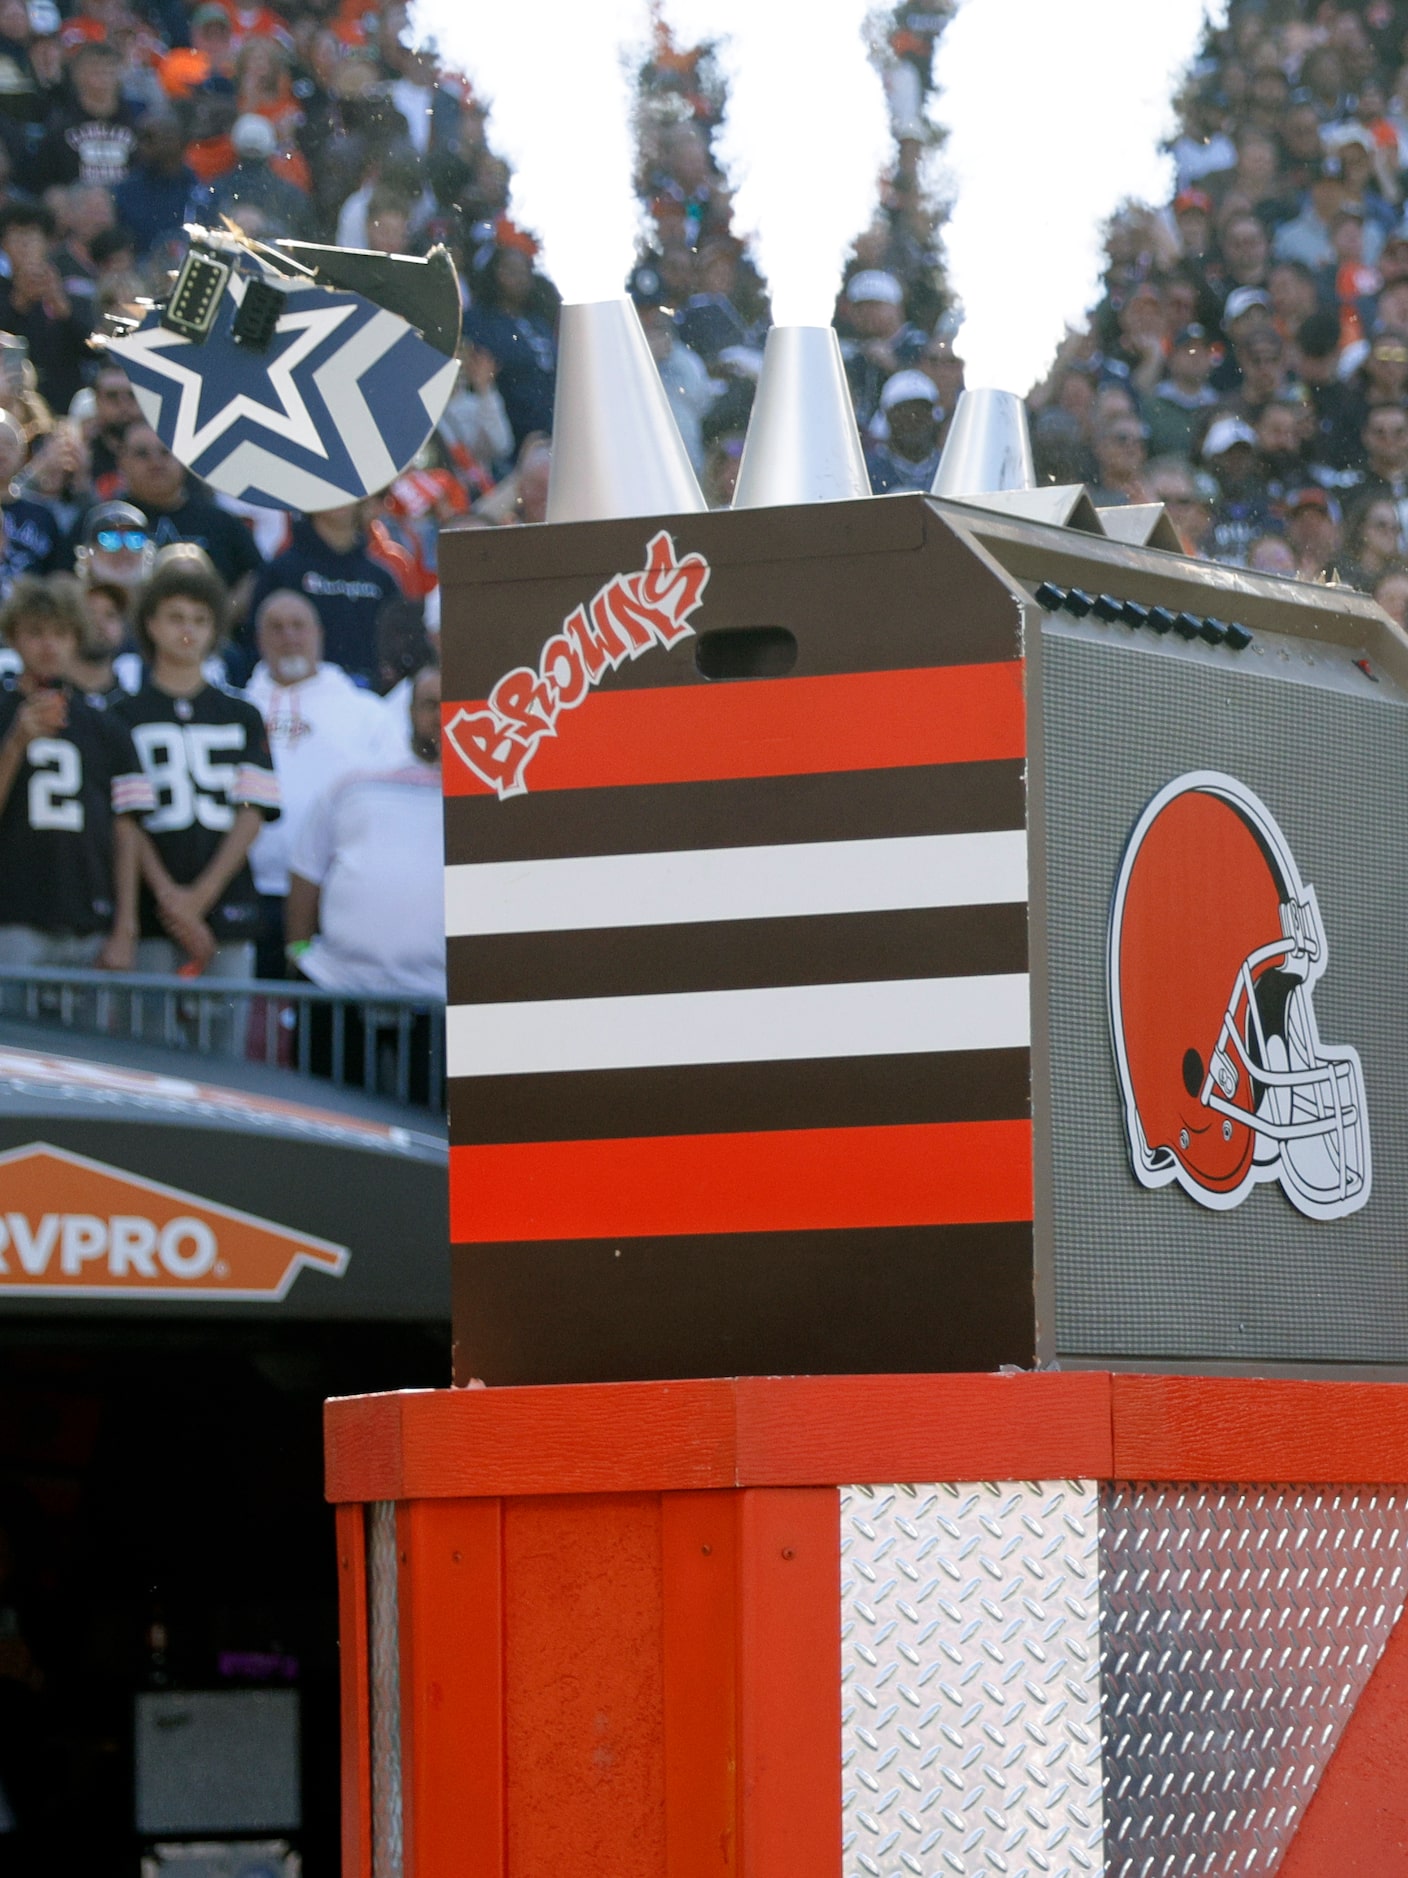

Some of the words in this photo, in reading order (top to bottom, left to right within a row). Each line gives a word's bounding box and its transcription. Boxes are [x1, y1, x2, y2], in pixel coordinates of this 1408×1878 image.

[444, 530, 711, 801] BROWNS
[27, 737, 84, 832] 2
[131, 721, 246, 832] 85
[0, 1212, 218, 1280] VPRO
